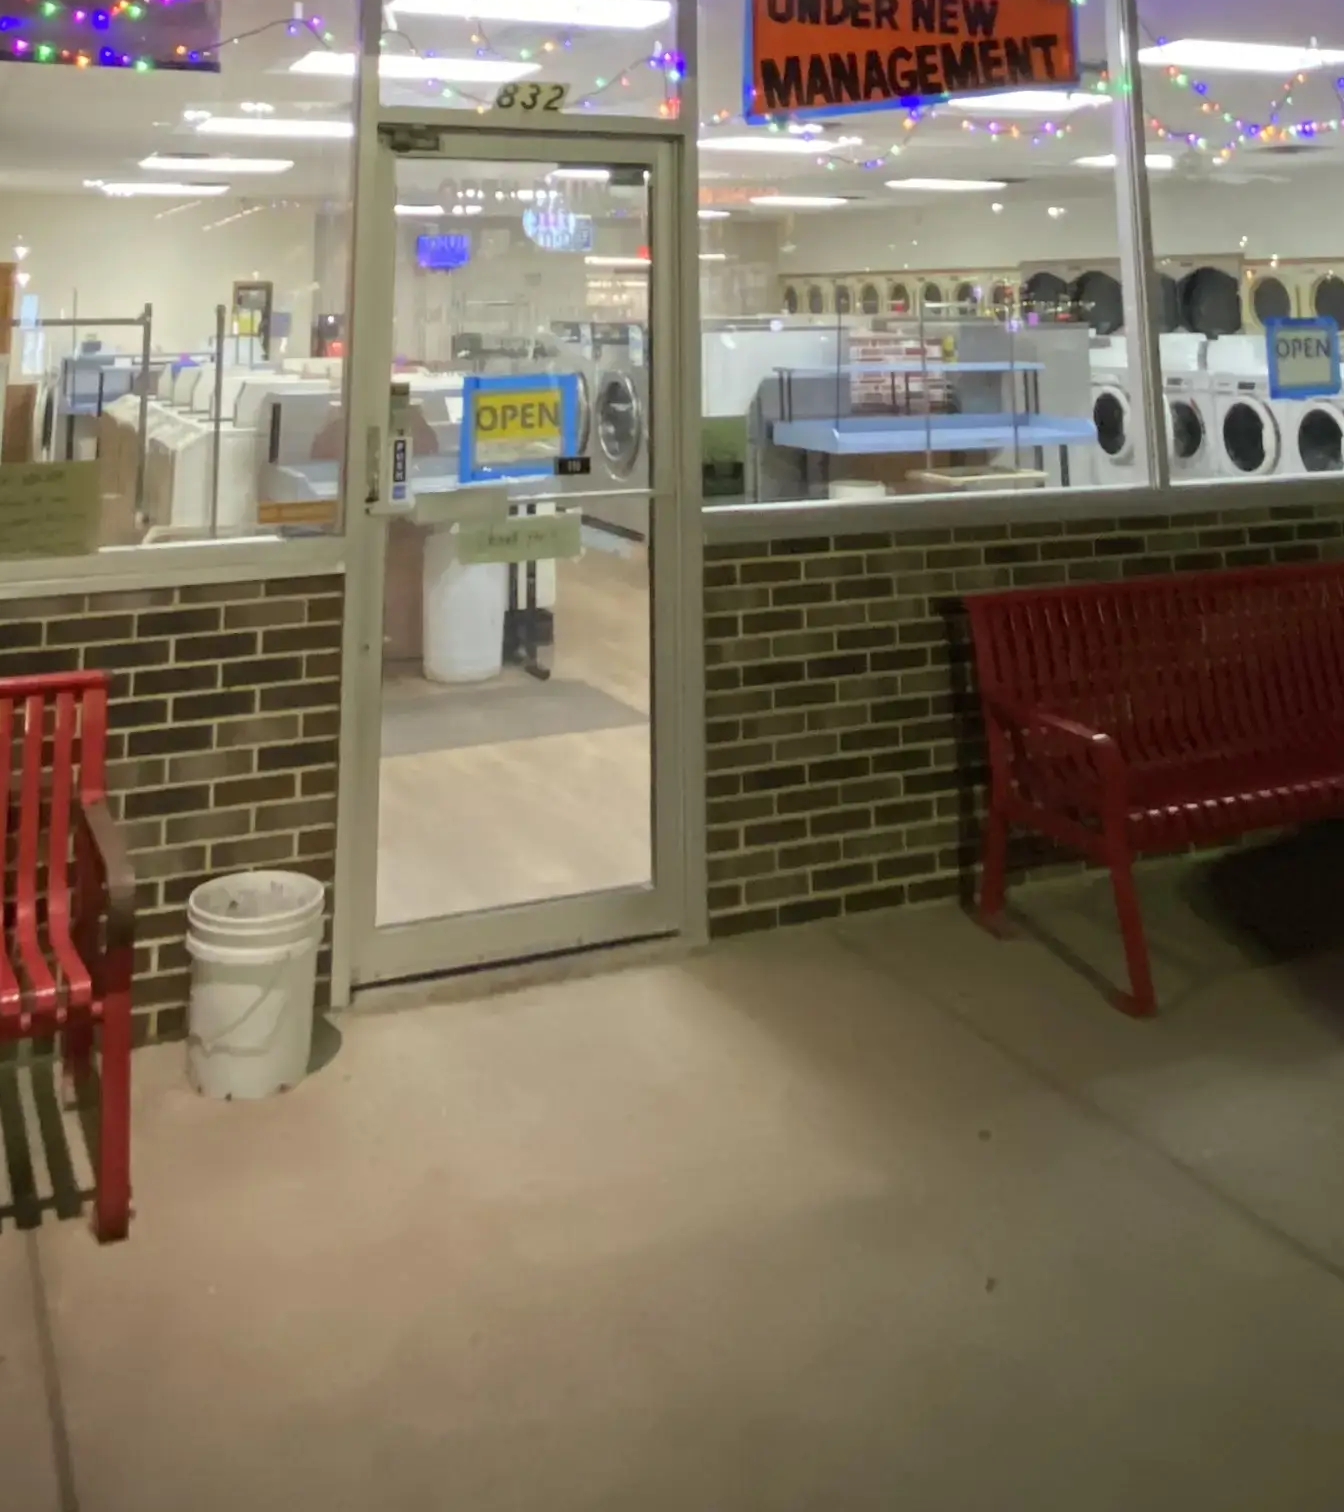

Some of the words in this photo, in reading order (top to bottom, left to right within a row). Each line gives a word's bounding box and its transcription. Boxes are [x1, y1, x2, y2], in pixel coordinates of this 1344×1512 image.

[759, 33, 1059, 110] MANAGEMENT
[494, 82, 565, 112] 832
[1274, 334, 1332, 360] OPEN
[476, 401, 561, 432] OPEN
